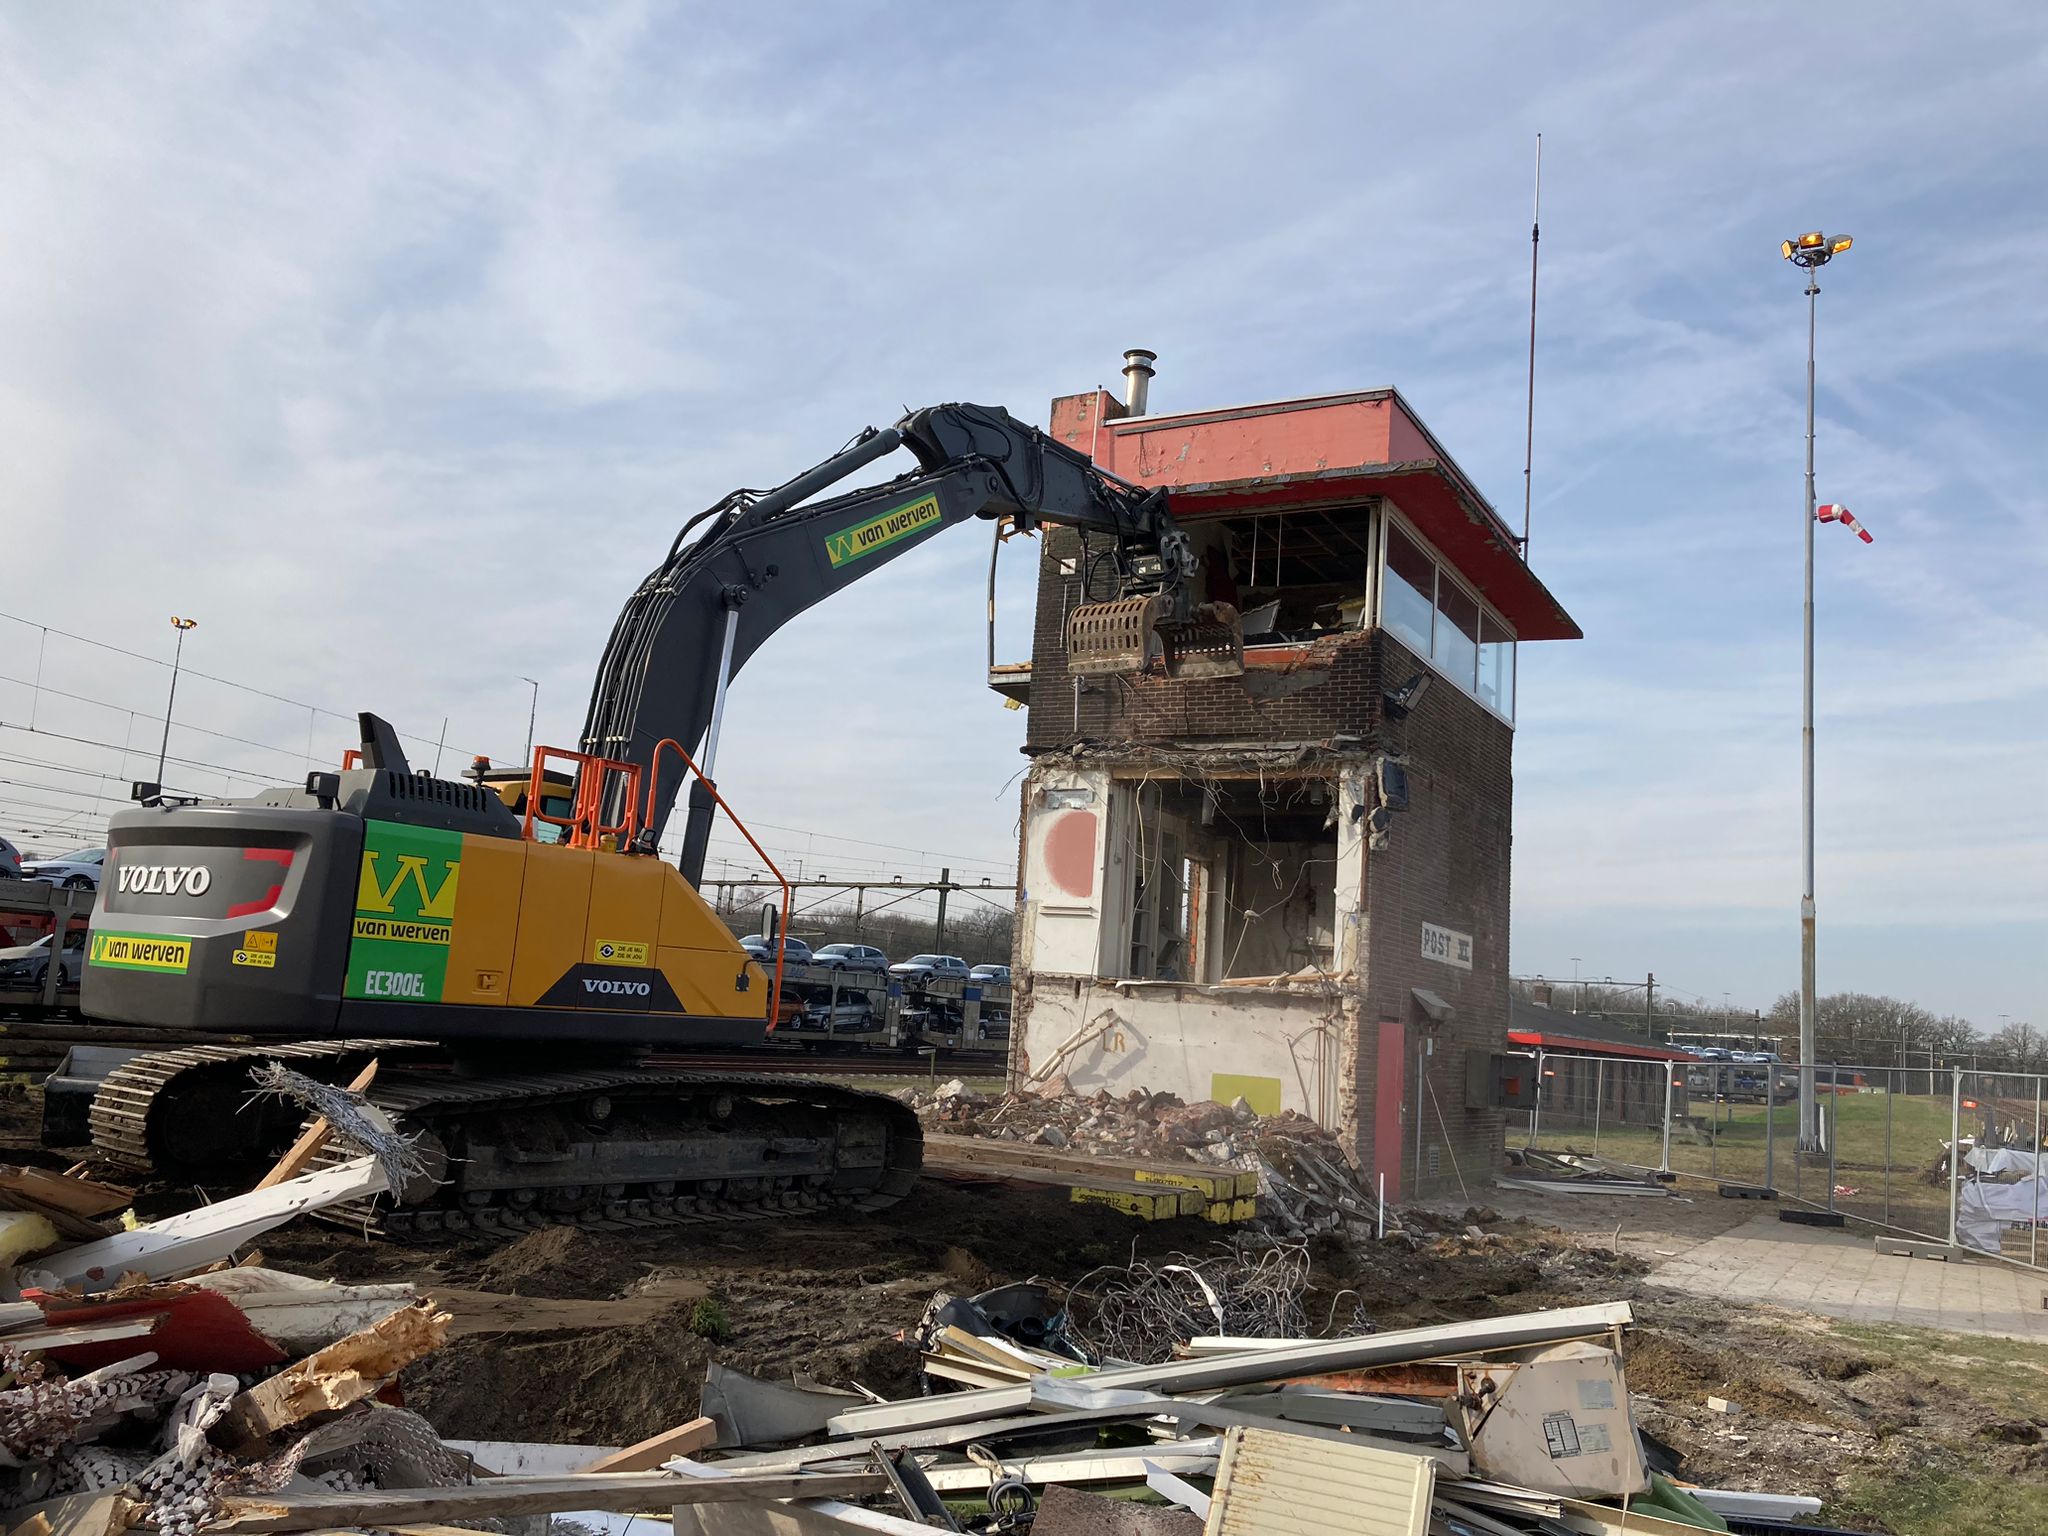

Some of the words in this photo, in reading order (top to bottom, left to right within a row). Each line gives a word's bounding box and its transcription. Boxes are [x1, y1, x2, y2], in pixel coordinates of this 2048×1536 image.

[857, 524, 885, 547] van
[886, 502, 936, 534] werven
[118, 865, 211, 897] VOLVO
[357, 921, 387, 936] van
[391, 924, 450, 941] werven
[1423, 928, 1451, 958] POST
[109, 941, 129, 959] van
[132, 943, 185, 963] werven
[582, 979, 650, 996] VOLVO
